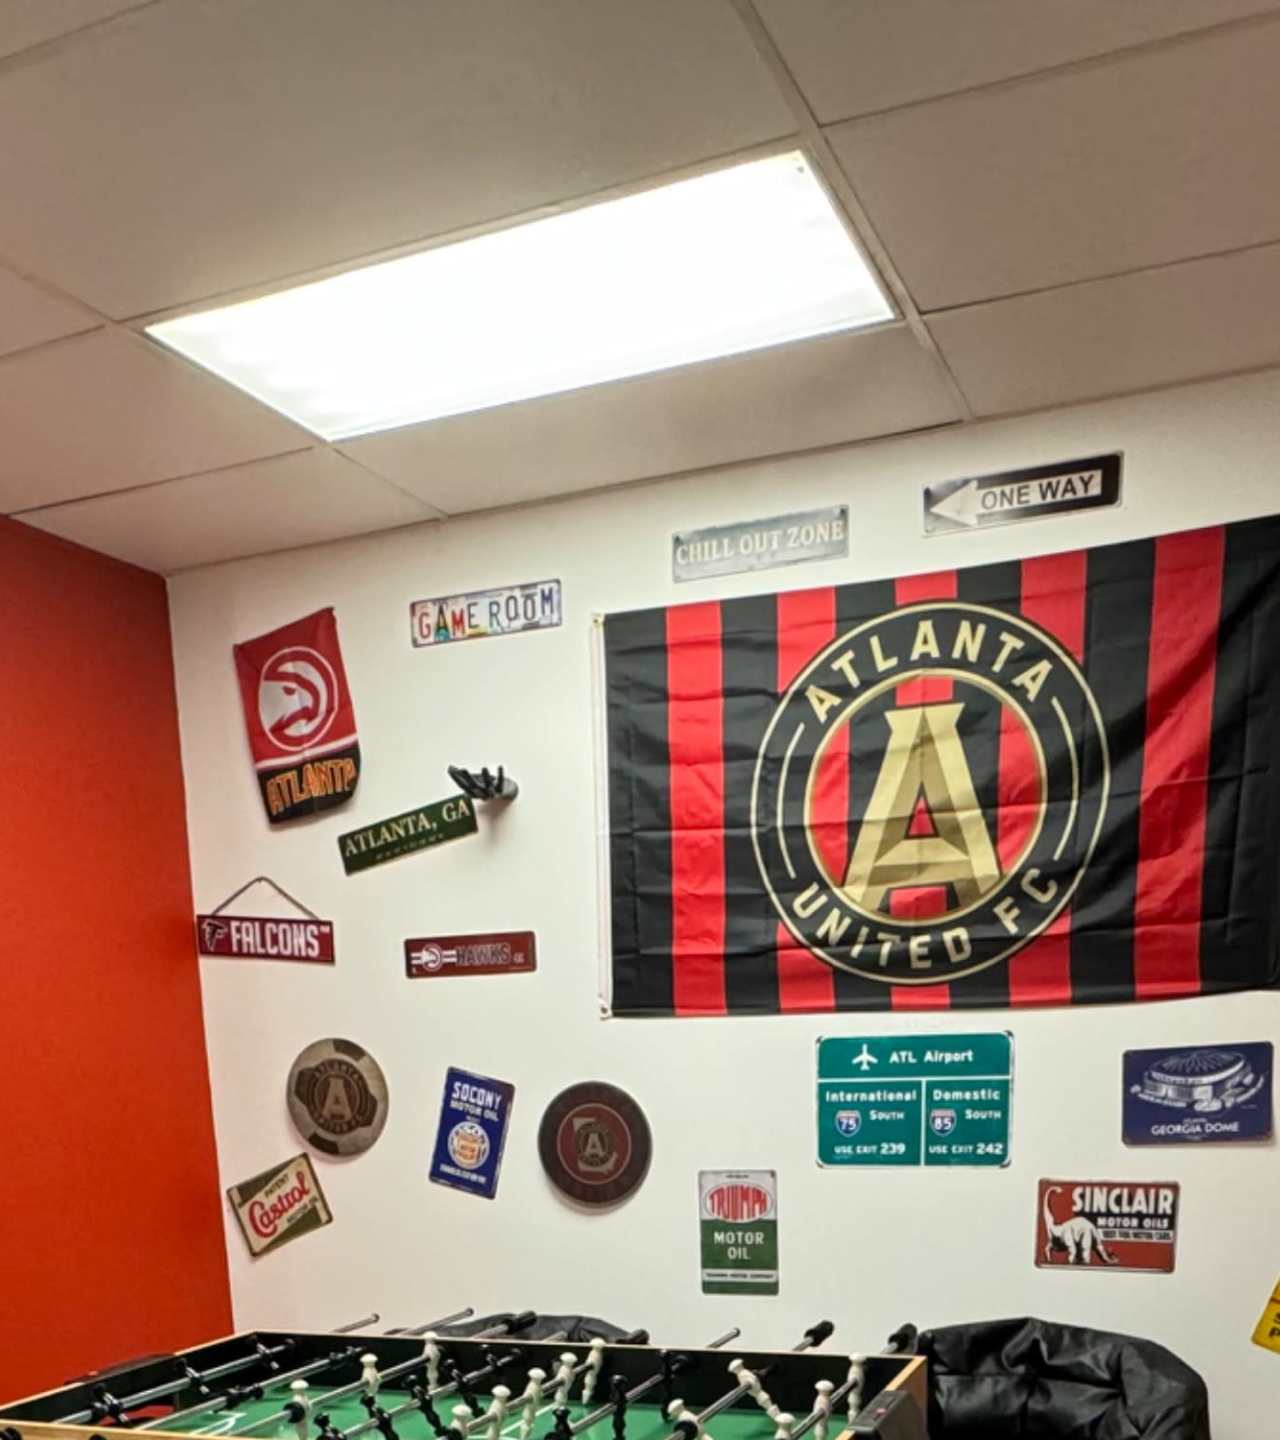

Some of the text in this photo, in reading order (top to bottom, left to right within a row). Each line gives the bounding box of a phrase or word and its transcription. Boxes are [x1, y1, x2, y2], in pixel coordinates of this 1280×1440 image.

[981, 474, 1095, 510] ONE WAY
[676, 520, 844, 564] CHILL OUT ZONE
[418, 586, 554, 642] GAME ROOM
[804, 618, 1055, 725] ATLANTA
[345, 812, 438, 857] ATLANTA,
[441, 799, 470, 822] GA
[791, 867, 1058, 969] UNITED FC
[229, 920, 320, 958] FALCONS
[889, 1049, 973, 1065] ATL Airport
[452, 1081, 502, 1110] SOCONY
[825, 1089, 917, 1103] International
[932, 1089, 1000, 1101] Domestic
[840, 1117, 857, 1131] 75
[933, 1117, 952, 1131] 85
[1151, 1121, 1239, 1136] GEORGIA DOME
[834, 1142, 906, 1155] USE EXIT 239
[928, 1142, 1003, 1155] USE EXIT 242
[249, 1171, 311, 1238] Castrol
[1072, 1186, 1174, 1215] SINCLAIR
[1097, 1216, 1169, 1229] MOTOR OILS
[713, 1231, 765, 1245] MOTOR
[727, 1246, 751, 1260] OIL
